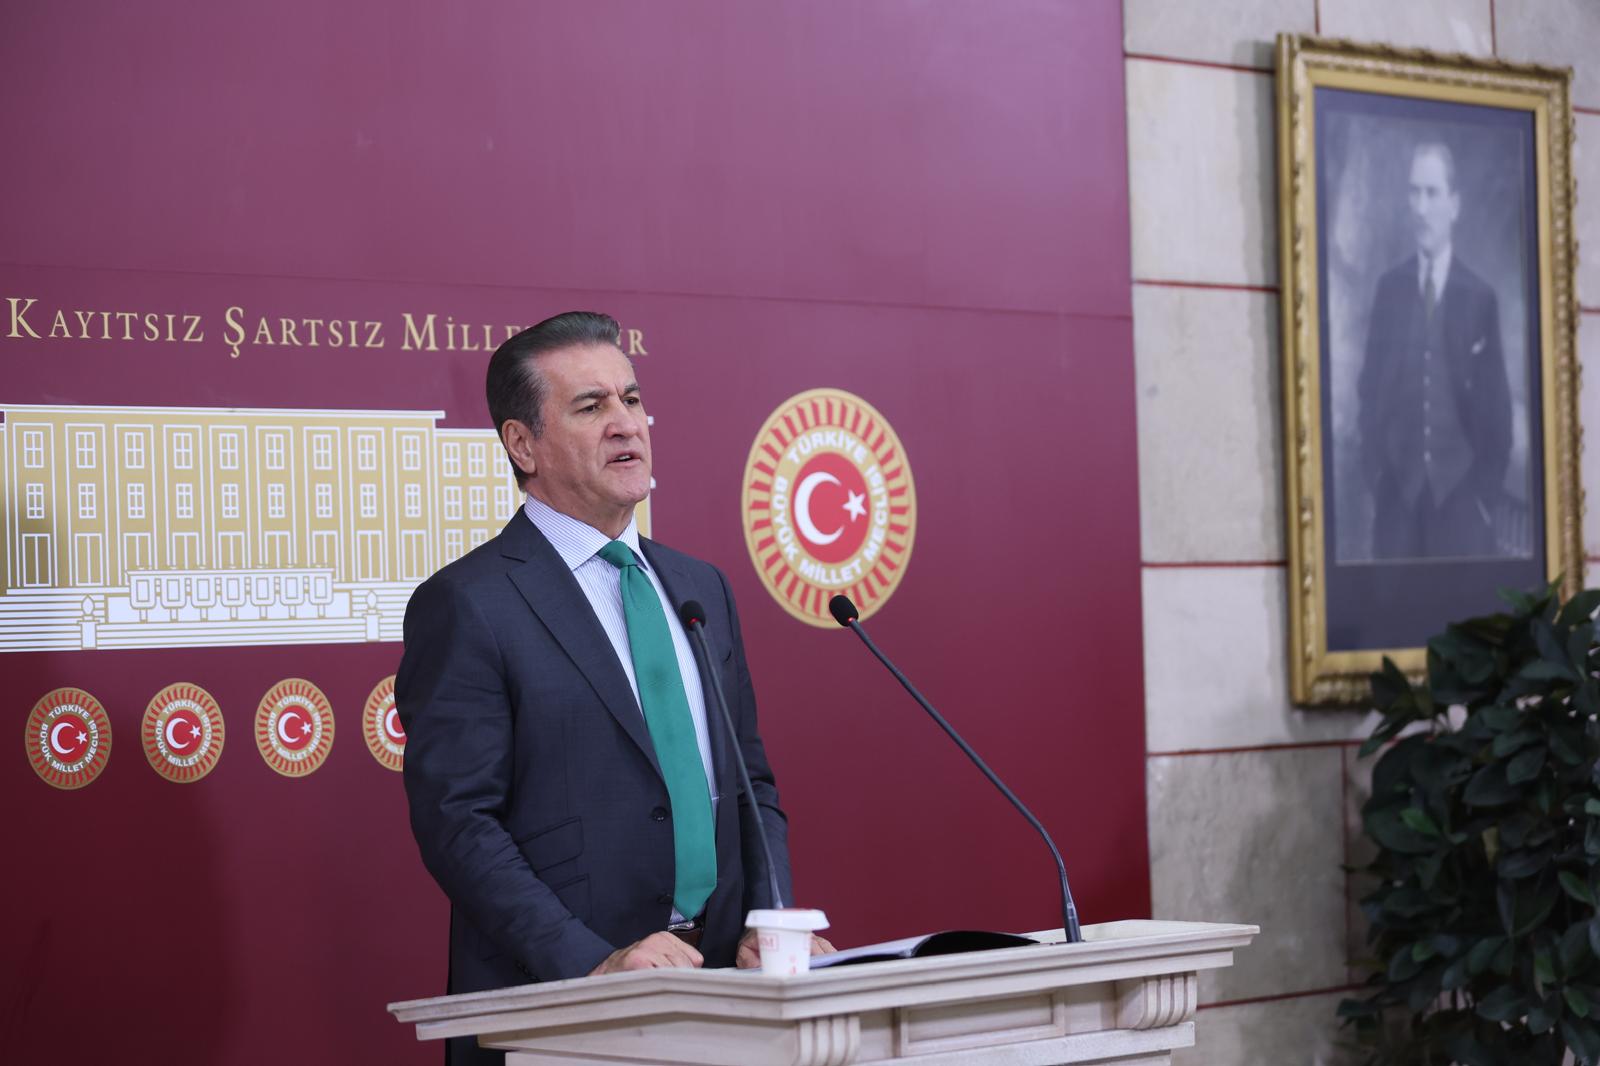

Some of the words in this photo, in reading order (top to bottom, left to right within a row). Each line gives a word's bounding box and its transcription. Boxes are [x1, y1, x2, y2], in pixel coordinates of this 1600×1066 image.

[6, 298, 204, 342] KAYITSIZ
[223, 306, 385, 358] ŞARTSIZ
[788, 430, 867, 464] TÜRKİYE
[800, 558, 863, 584] MİLLET
[48, 703, 90, 720] TÜRKİYE
[51, 760, 84, 773] MİLLET
